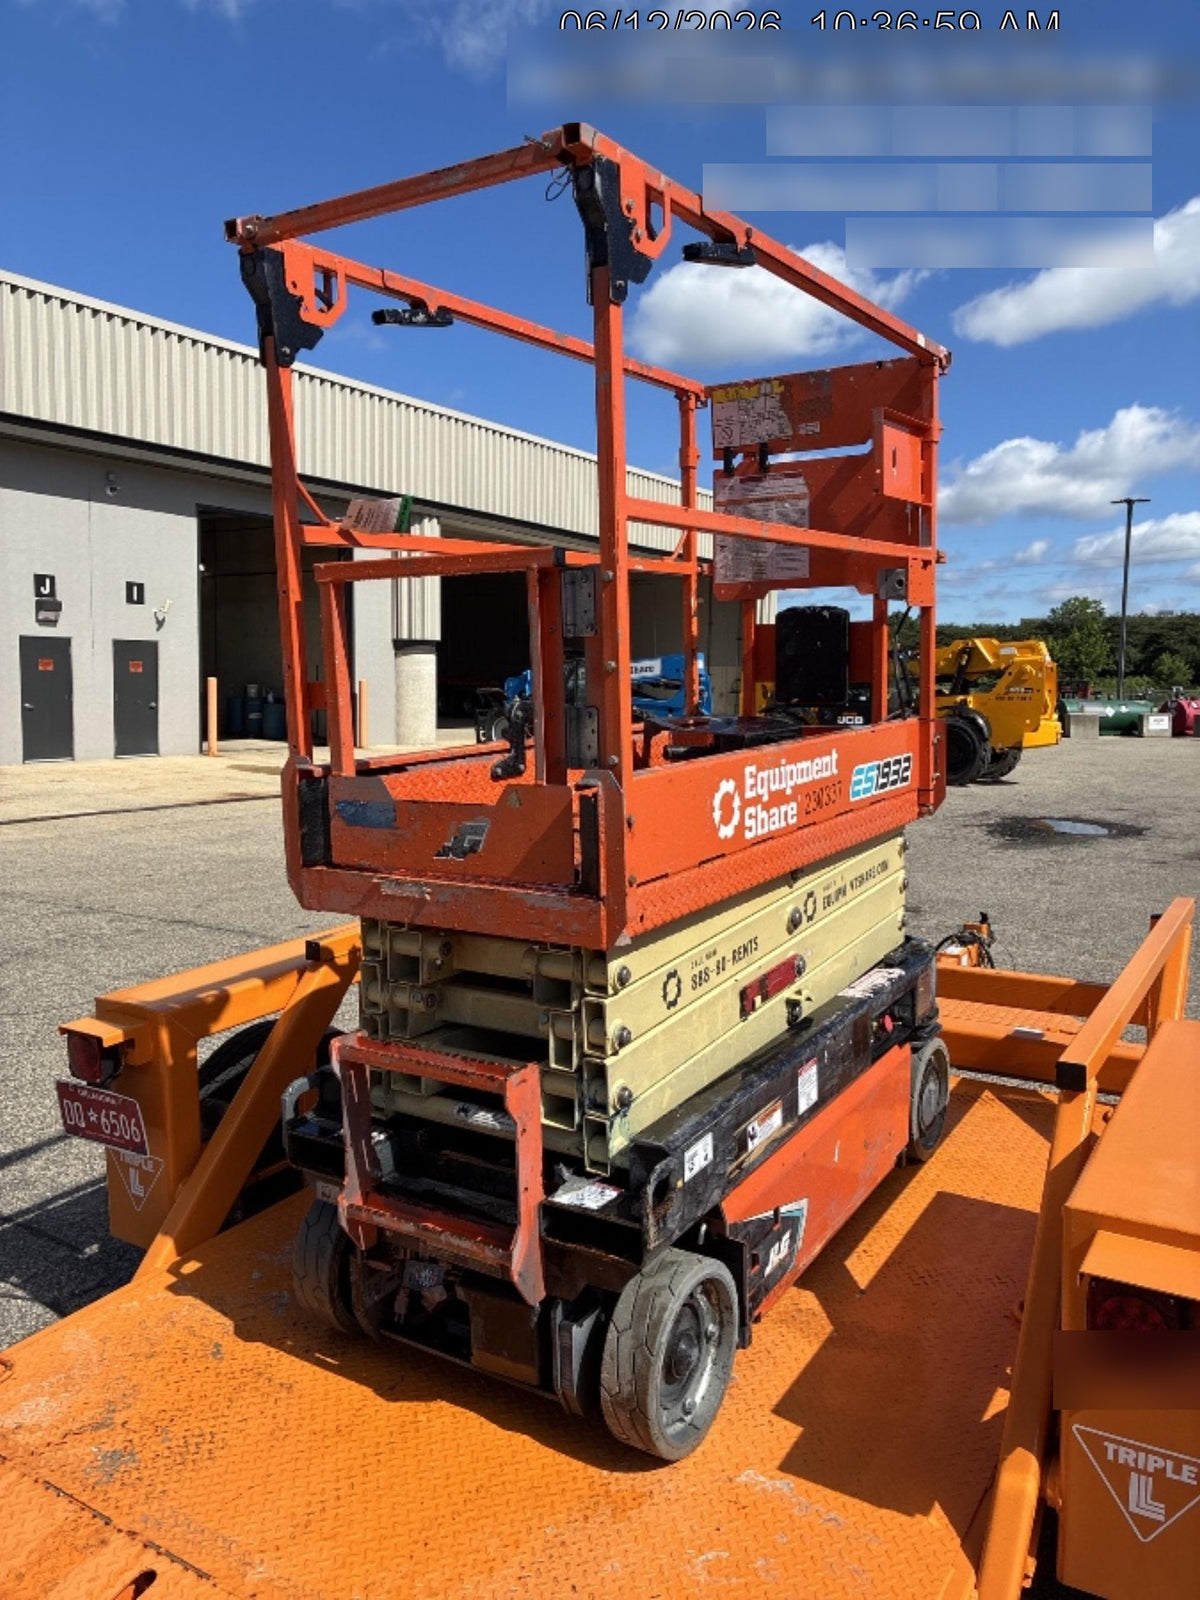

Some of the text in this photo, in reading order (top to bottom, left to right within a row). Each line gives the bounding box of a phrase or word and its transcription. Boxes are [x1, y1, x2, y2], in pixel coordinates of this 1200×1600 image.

[40, 577, 51, 594] J
[837, 715, 863, 724] JCB
[744, 748, 838, 802] Equipment
[851, 755, 911, 800] ES1932
[744, 801, 797, 839] Share
[100, 1108, 141, 1143] 6506
[1104, 1441, 1198, 1486] TRIPLE
